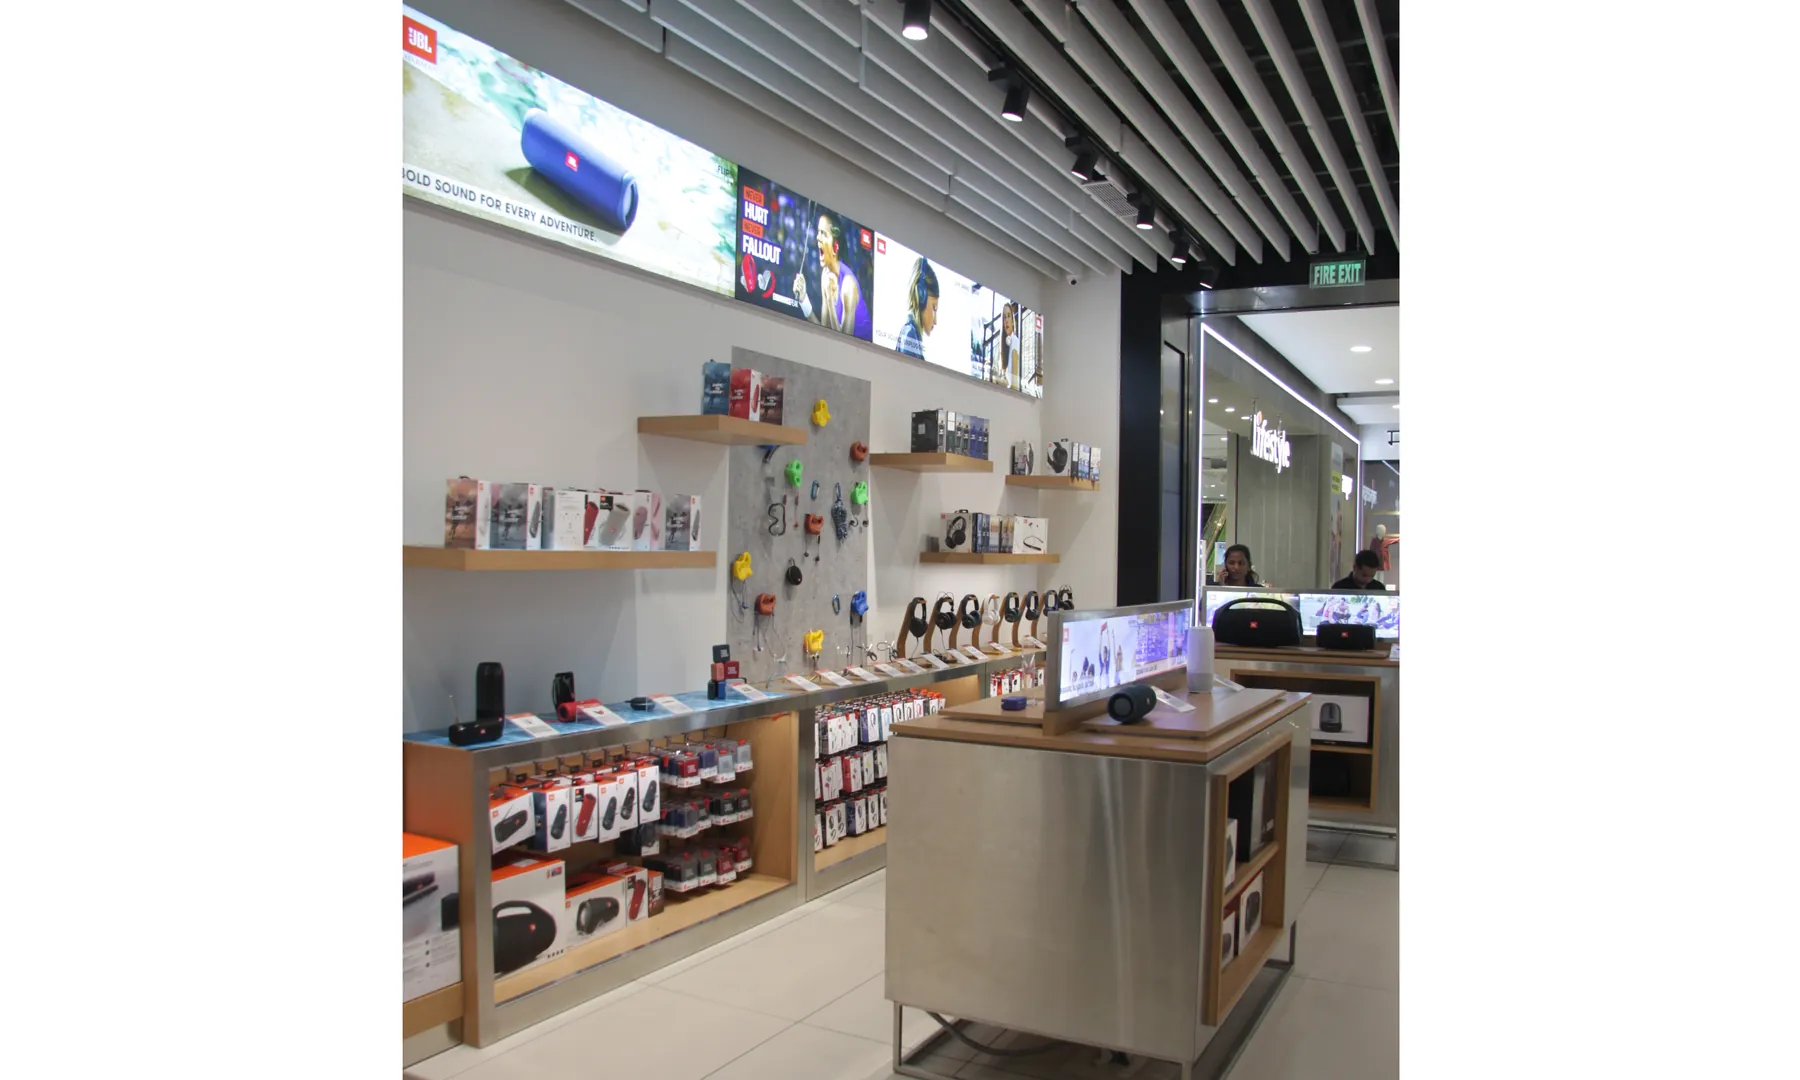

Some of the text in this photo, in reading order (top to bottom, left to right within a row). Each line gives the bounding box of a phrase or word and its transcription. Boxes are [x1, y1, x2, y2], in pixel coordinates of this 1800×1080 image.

[408, 26, 433, 54] JBL
[435, 179, 477, 202] SOUND
[480, 194, 502, 212] FOR
[505, 202, 537, 221] EVERY
[539, 214, 598, 242] ADVENTURE.
[744, 200, 769, 226] HURT
[742, 234, 782, 265] FALLOUT
[1313, 263, 1362, 285] FIRE EXIT
[1252, 410, 1291, 474] lifestyle
